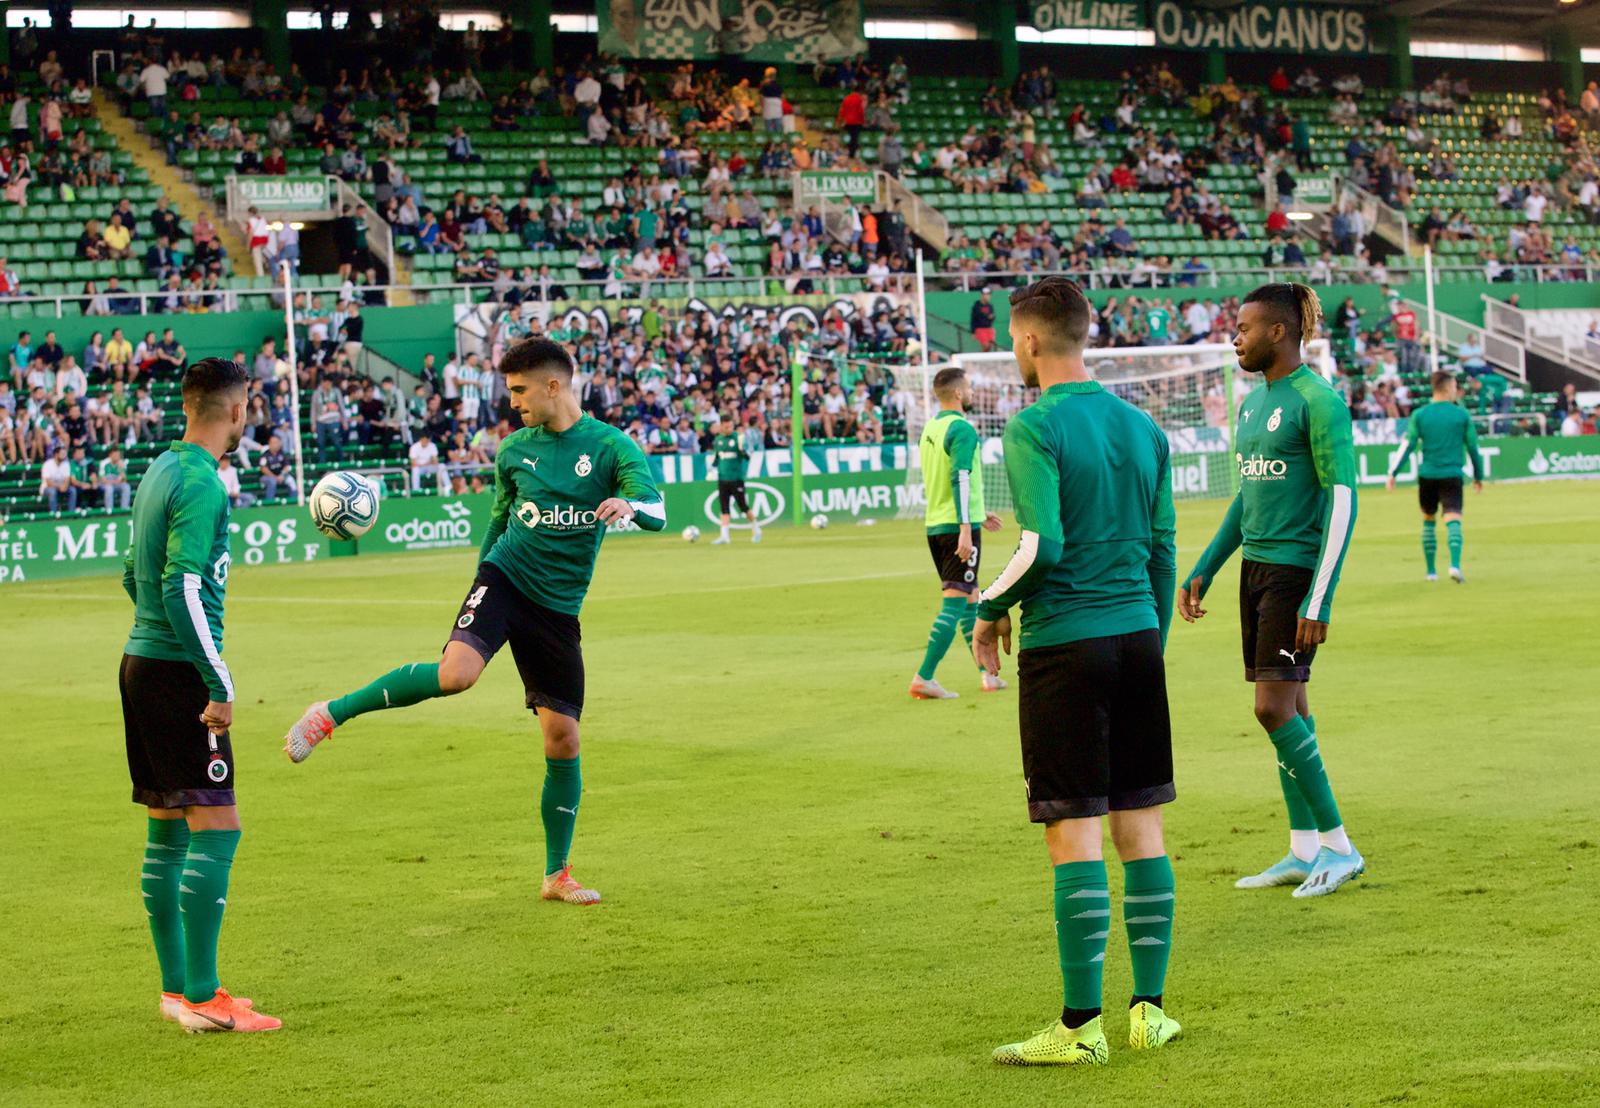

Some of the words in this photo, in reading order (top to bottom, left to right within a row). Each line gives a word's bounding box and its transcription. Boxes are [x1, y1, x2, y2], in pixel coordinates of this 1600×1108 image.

[1034, 1, 1137, 28] ONLINE
[265, 181, 324, 199] DIARIO
[802, 176, 821, 192] EL
[822, 176, 875, 192] DIARIO
[1242, 454, 1287, 476] aldro
[541, 504, 598, 526] aldro
[385, 518, 472, 544] adamo
